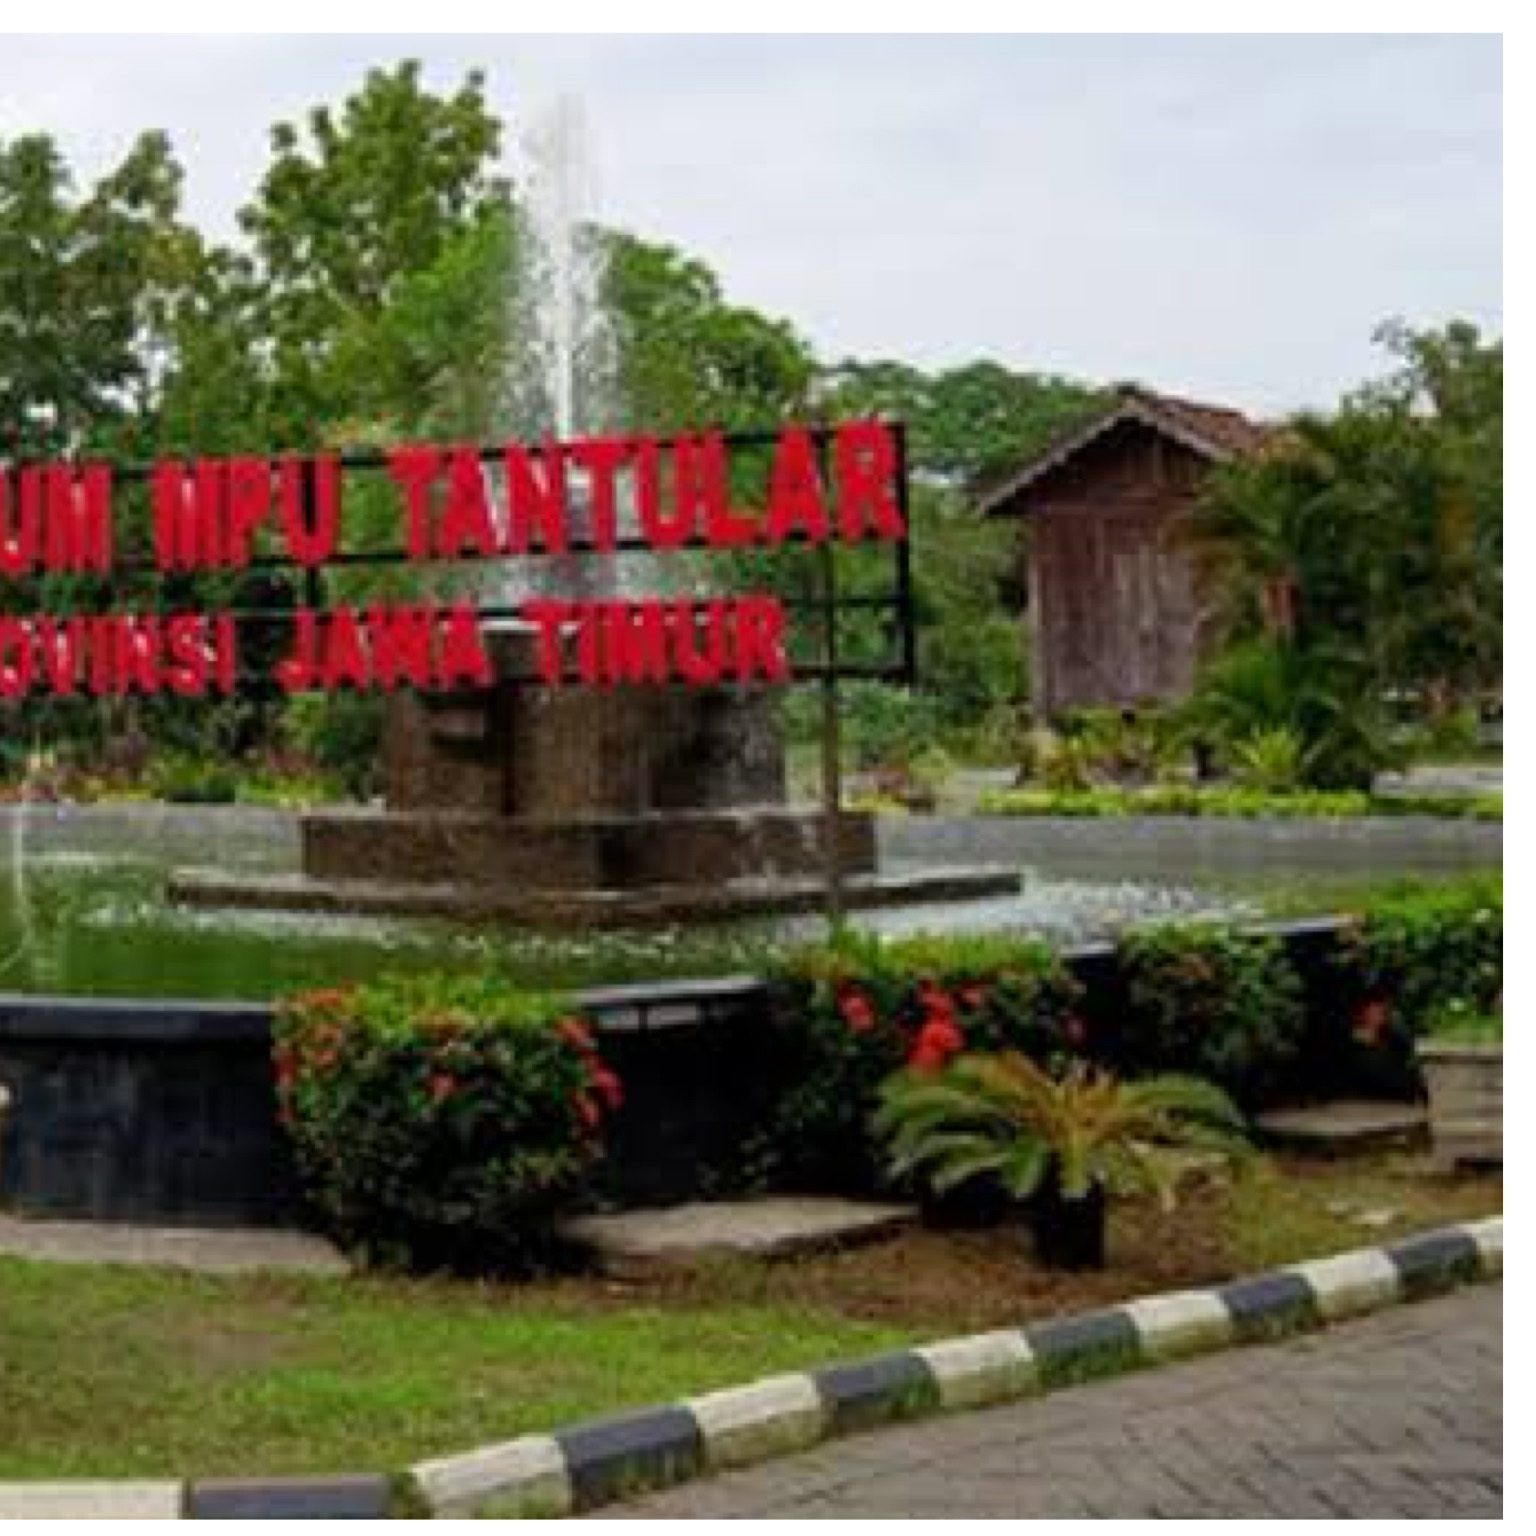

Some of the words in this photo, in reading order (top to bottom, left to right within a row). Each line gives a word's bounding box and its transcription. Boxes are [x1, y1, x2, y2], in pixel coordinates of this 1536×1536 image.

[151, 455, 337, 568] MPU
[389, 419, 904, 556] TANTULAR
[277, 603, 490, 692] JAWA
[521, 595, 787, 682] TIMUR
